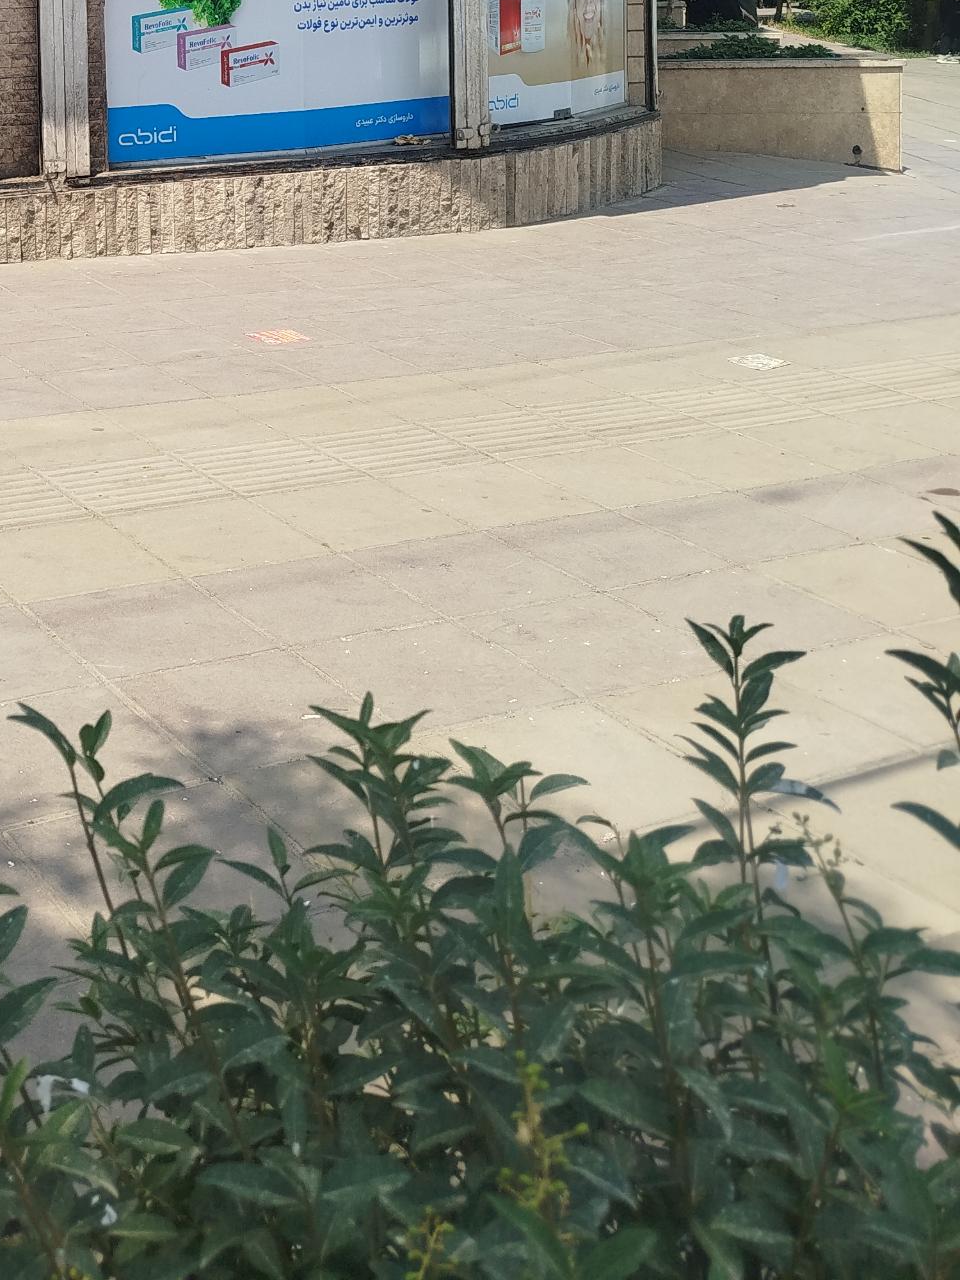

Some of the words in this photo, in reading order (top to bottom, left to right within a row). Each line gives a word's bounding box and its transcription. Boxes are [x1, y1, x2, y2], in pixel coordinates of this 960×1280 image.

[293, 1, 311, 13] بدن
[297, 16, 322, 32] فولات
[323, 17, 339, 33] نوع
[384, 12, 419, 26] موثرترین
[355, 117, 374, 128] عبیدی
[374, 116, 387, 126] دکتر
[388, 112, 414, 125] داروسازی
[118, 125, 177, 146] abidi
